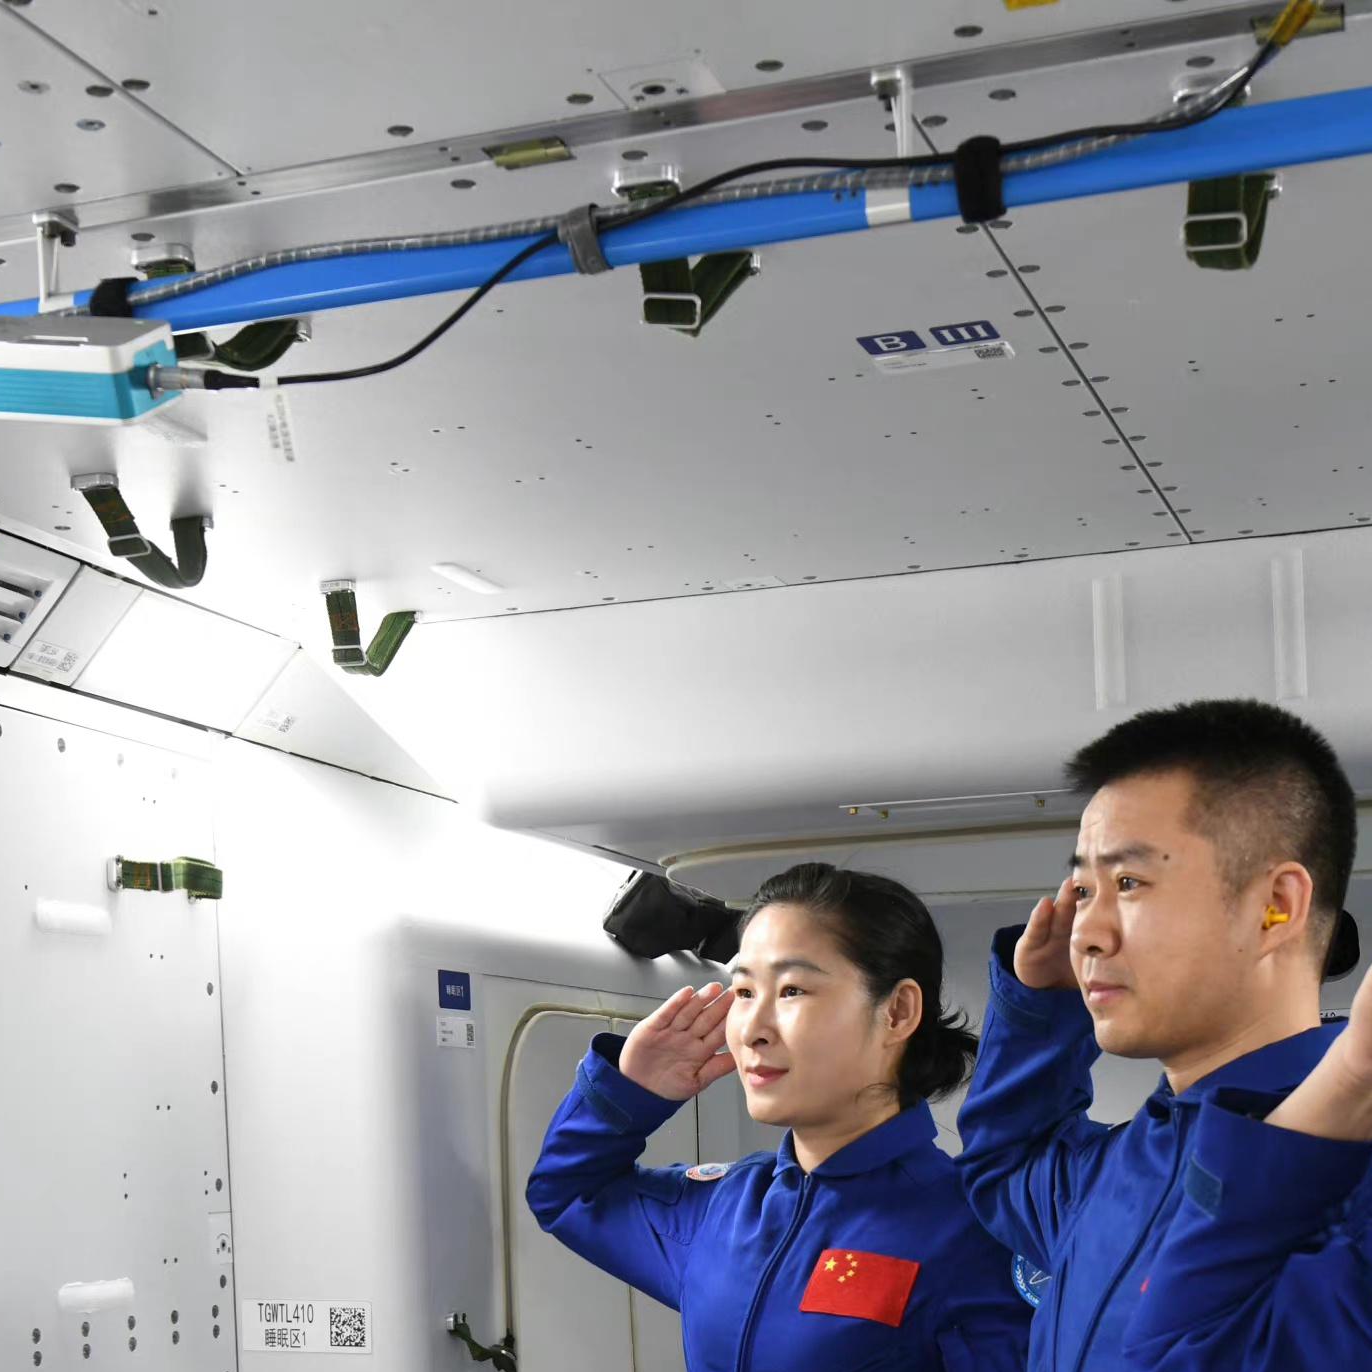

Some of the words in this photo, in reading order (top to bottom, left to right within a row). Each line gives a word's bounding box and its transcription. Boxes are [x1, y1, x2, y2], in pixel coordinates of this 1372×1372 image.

[873, 335, 907, 351] B
[258, 1303, 314, 1324] TGWTL410
[265, 1328, 307, 1348] 睡眠区1
